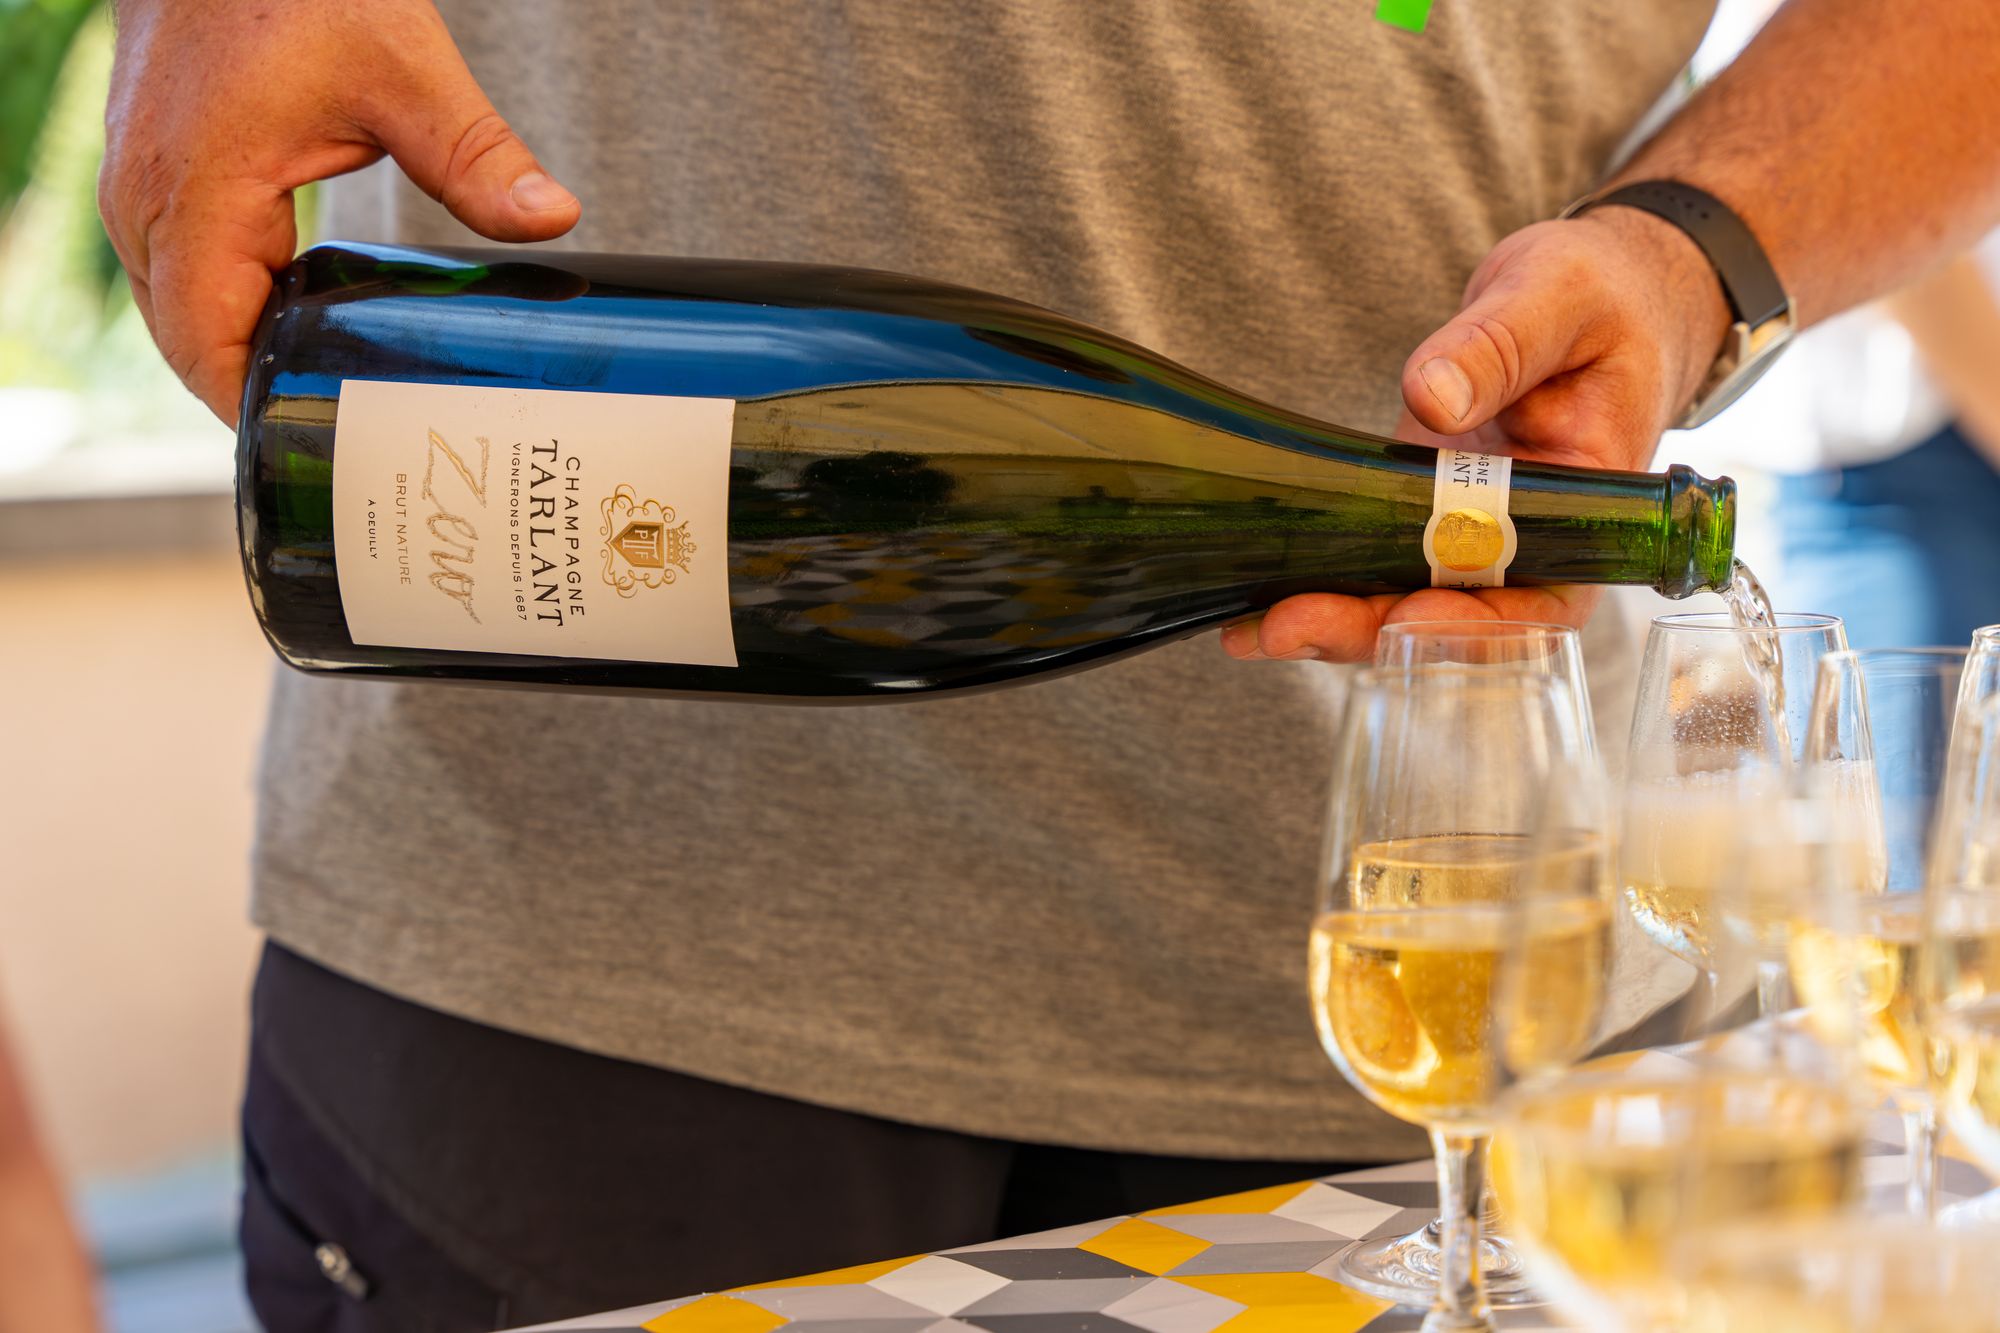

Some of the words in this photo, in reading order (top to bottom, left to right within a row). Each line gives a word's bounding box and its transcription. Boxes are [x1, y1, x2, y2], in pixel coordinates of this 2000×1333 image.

[396, 473, 408, 518] BRUT
[510, 443, 522, 528] VIGNERONS
[367, 511, 378, 560] OEUILLY
[396, 524, 411, 585] NATURE
[422, 427, 490, 625] Zero
[530, 439, 563, 627] TARLANT
[565, 457, 585, 617] CHAMPAGNE
[510, 533, 522, 583] DEPUIS
[514, 588, 527, 621] 1687
